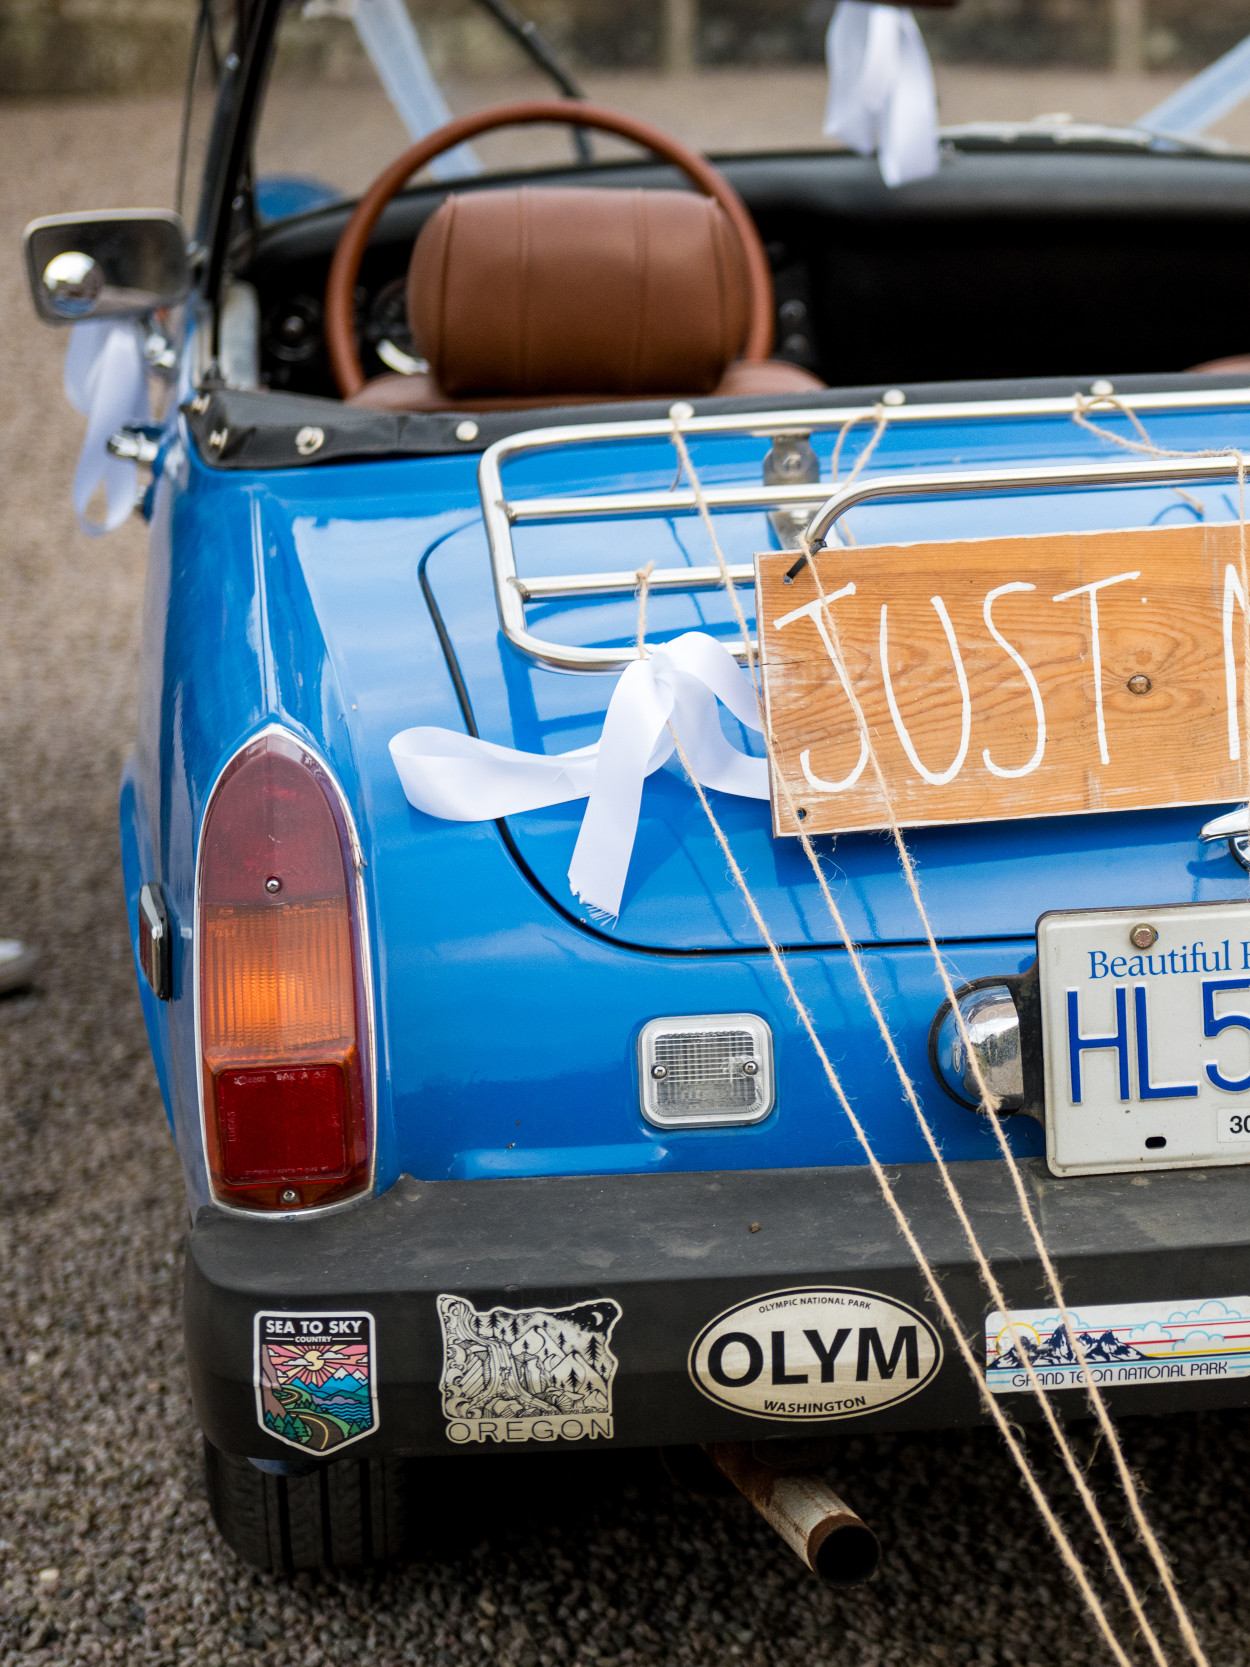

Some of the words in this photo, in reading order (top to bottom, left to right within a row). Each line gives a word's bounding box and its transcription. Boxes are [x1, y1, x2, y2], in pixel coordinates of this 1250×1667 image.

[773, 570, 1141, 794] JUST
[1089, 941, 1231, 979] Beautiful
[758, 1298, 798, 1314] OLYMPIC
[800, 1296, 846, 1306] NATIONAL
[848, 1298, 872, 1310] PARK
[265, 1320, 296, 1333] SEA
[300, 1320, 324, 1334] TO
[328, 1320, 363, 1334] SKY
[294, 1335, 333, 1343] COUNTRY
[707, 1325, 920, 1388] OLYM
[1069, 1368, 1113, 1383] TEON
[1118, 1364, 1187, 1381] NATIONAL
[1190, 1361, 1228, 1376] PARK
[763, 1395, 866, 1413] WASHINGTON
[447, 1418, 613, 1442] OREGON
